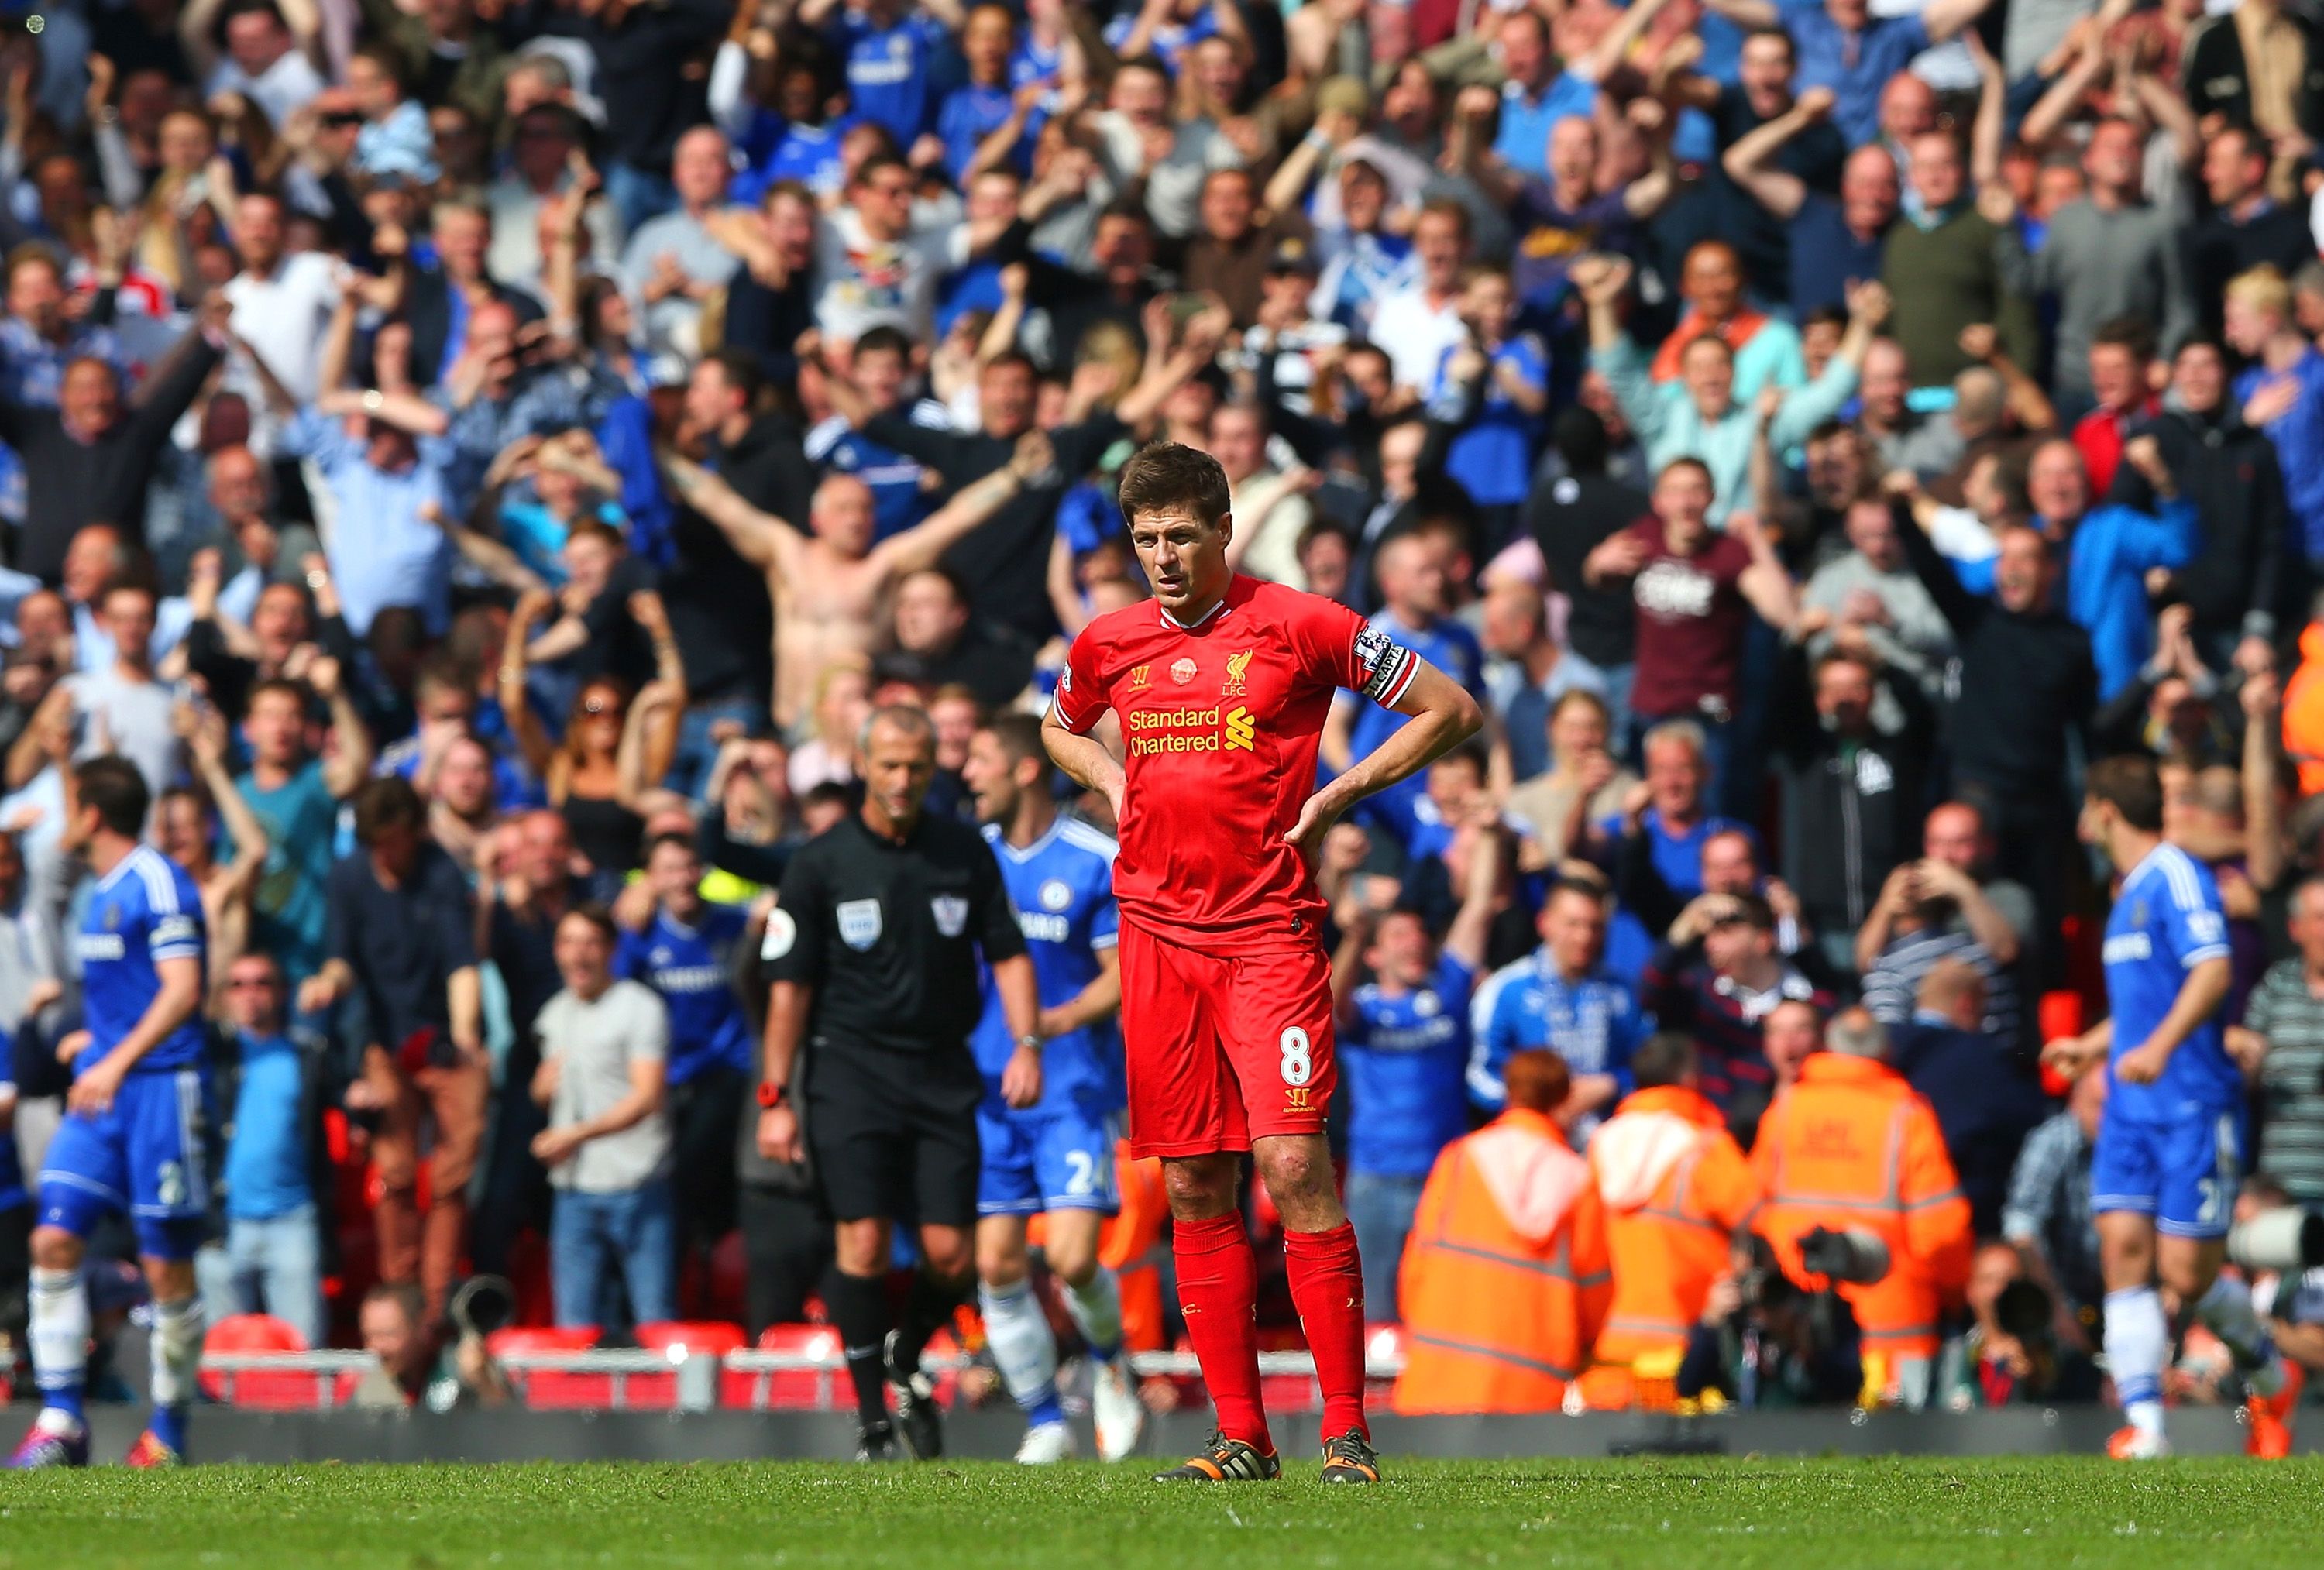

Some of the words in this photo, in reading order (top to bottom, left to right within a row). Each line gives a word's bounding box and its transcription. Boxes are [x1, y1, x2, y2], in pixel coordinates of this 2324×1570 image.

[1376, 647, 1402, 683] CAPTA
[1129, 706, 1220, 731] Standard
[1130, 730, 1220, 758] Chartered
[1280, 1026, 1312, 1087] 8
